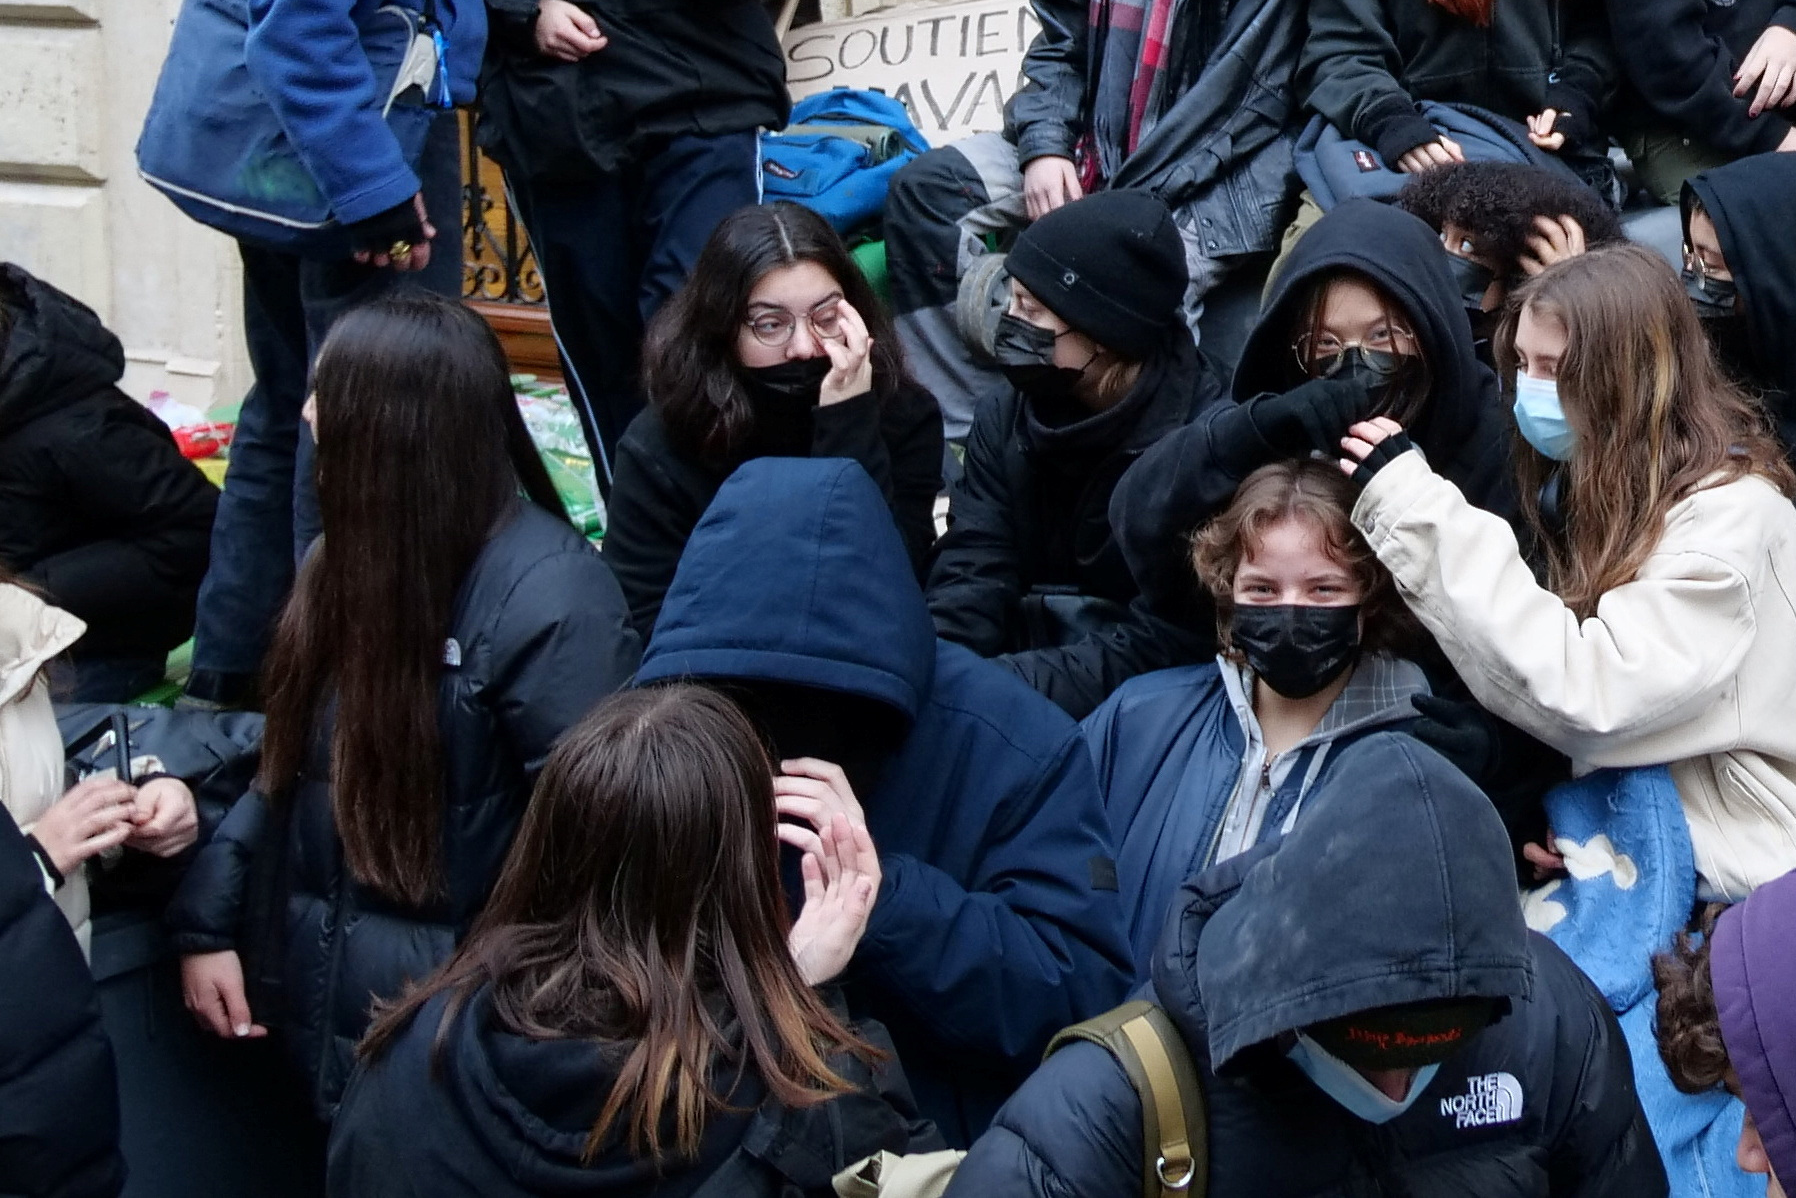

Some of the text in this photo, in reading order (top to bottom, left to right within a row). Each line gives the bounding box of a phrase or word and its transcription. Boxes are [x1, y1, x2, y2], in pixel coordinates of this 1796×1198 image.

[1467, 1073, 1499, 1094] THE
[1440, 1089, 1497, 1117] NORTH
[1456, 1108, 1497, 1130] FACE
